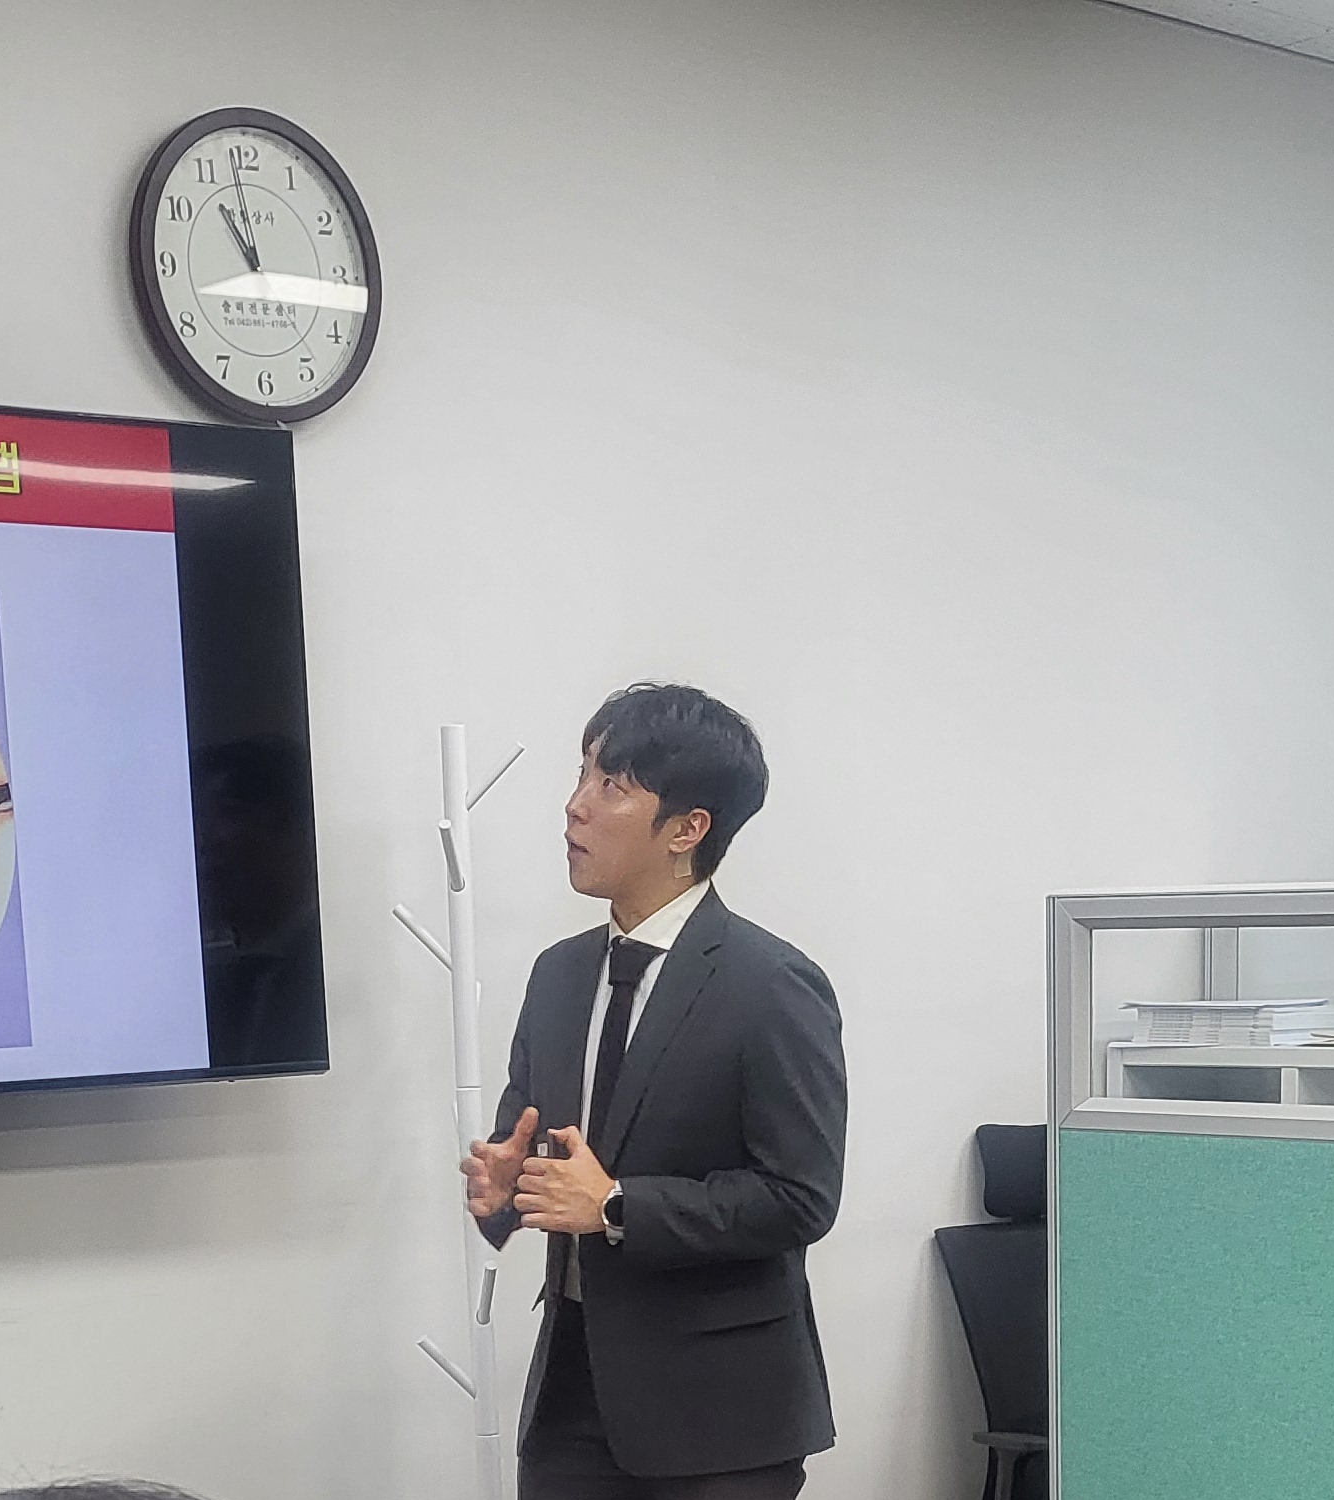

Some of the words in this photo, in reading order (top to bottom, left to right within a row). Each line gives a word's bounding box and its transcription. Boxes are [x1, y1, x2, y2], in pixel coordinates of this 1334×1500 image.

[194, 157, 218, 184] 11
[234, 145, 260, 171] 12
[283, 165, 297, 191] 1
[166, 194, 193, 222] 10
[316, 210, 333, 236] 2
[159, 250, 177, 277] 9
[332, 265, 349, 286] 3
[179, 311, 197, 338] 8
[325, 319, 343, 345] 4
[216, 354, 231, 380] 7
[298, 357, 315, 382] 5
[257, 370, 274, 396] 6
